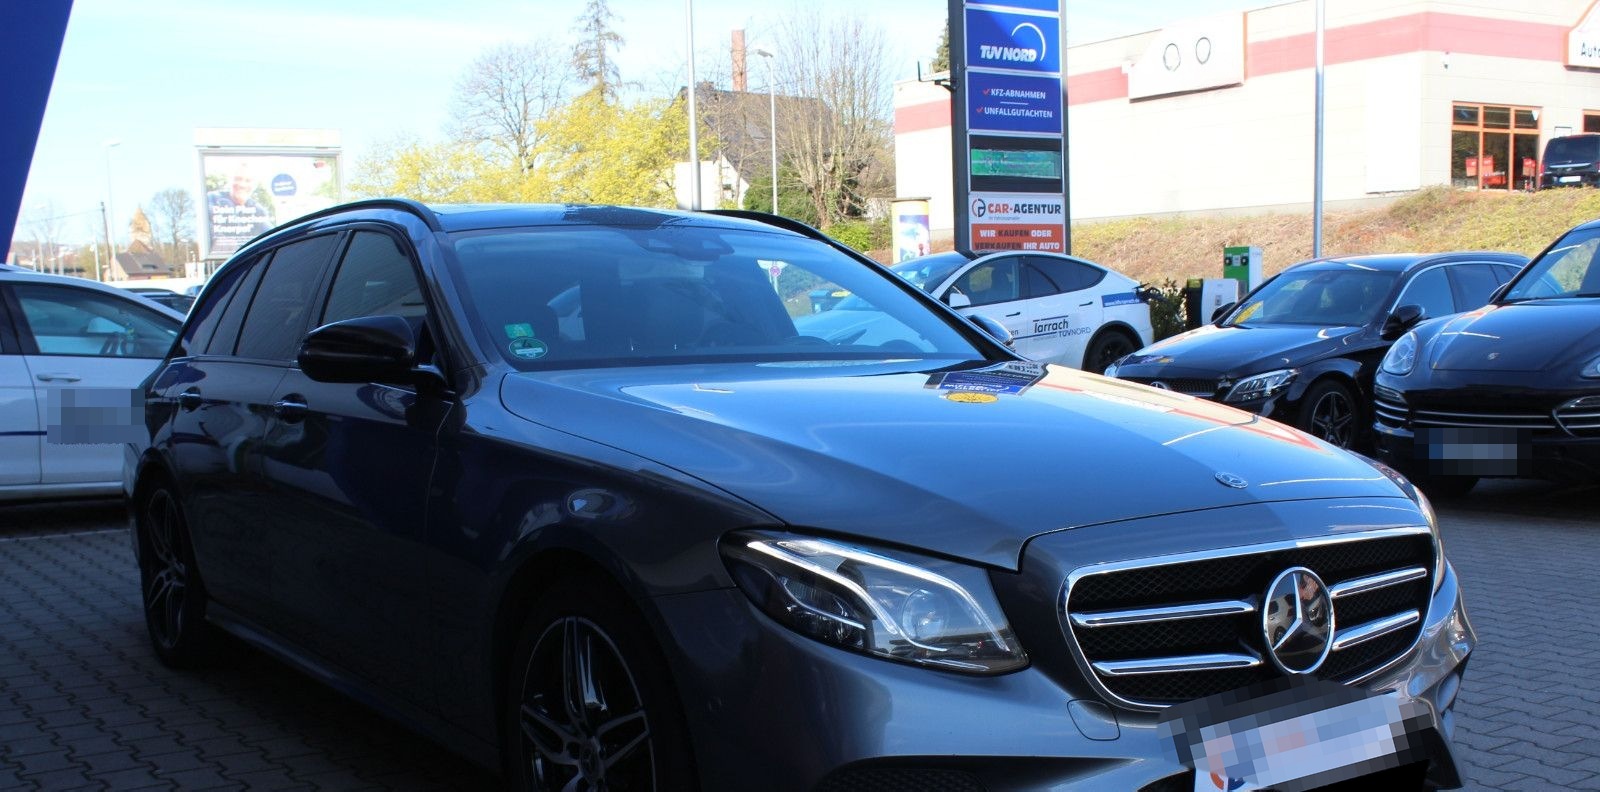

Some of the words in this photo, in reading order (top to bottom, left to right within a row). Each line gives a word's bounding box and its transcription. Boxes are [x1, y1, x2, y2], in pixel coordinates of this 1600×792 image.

[1003, 47, 1037, 62] NORD
[991, 88, 1046, 99] KFZ-ABNAHMEN
[984, 107, 1053, 118] UNFALLGUTACHTEN
[988, 203, 1061, 214] CAR-AGENTUR
[980, 230, 996, 238] WIR
[1031, 230, 1052, 238] ODER
[1023, 242, 1037, 250] IHR
[1038, 242, 1060, 250] AUTO
